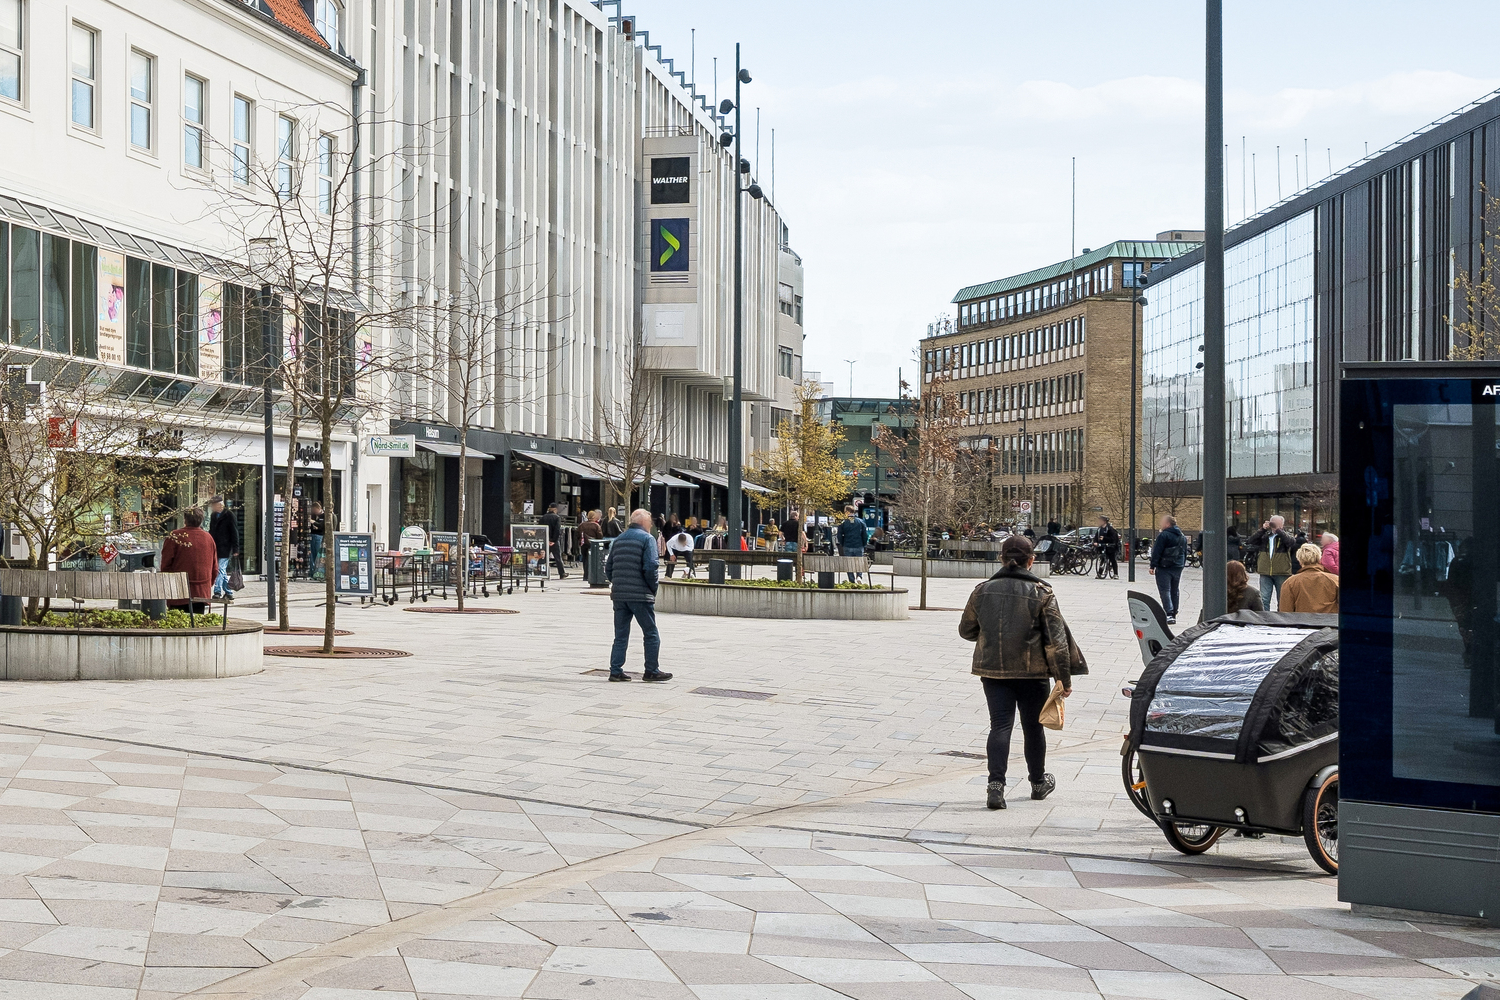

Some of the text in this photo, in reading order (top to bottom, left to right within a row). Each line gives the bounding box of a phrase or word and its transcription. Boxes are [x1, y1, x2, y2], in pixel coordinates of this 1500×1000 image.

[652, 176, 688, 184] WALTHER
[1482, 385, 1500, 395] AF
[374, 442, 409, 450] Nord-Smil.dk
[516, 541, 544, 549] MAGT
